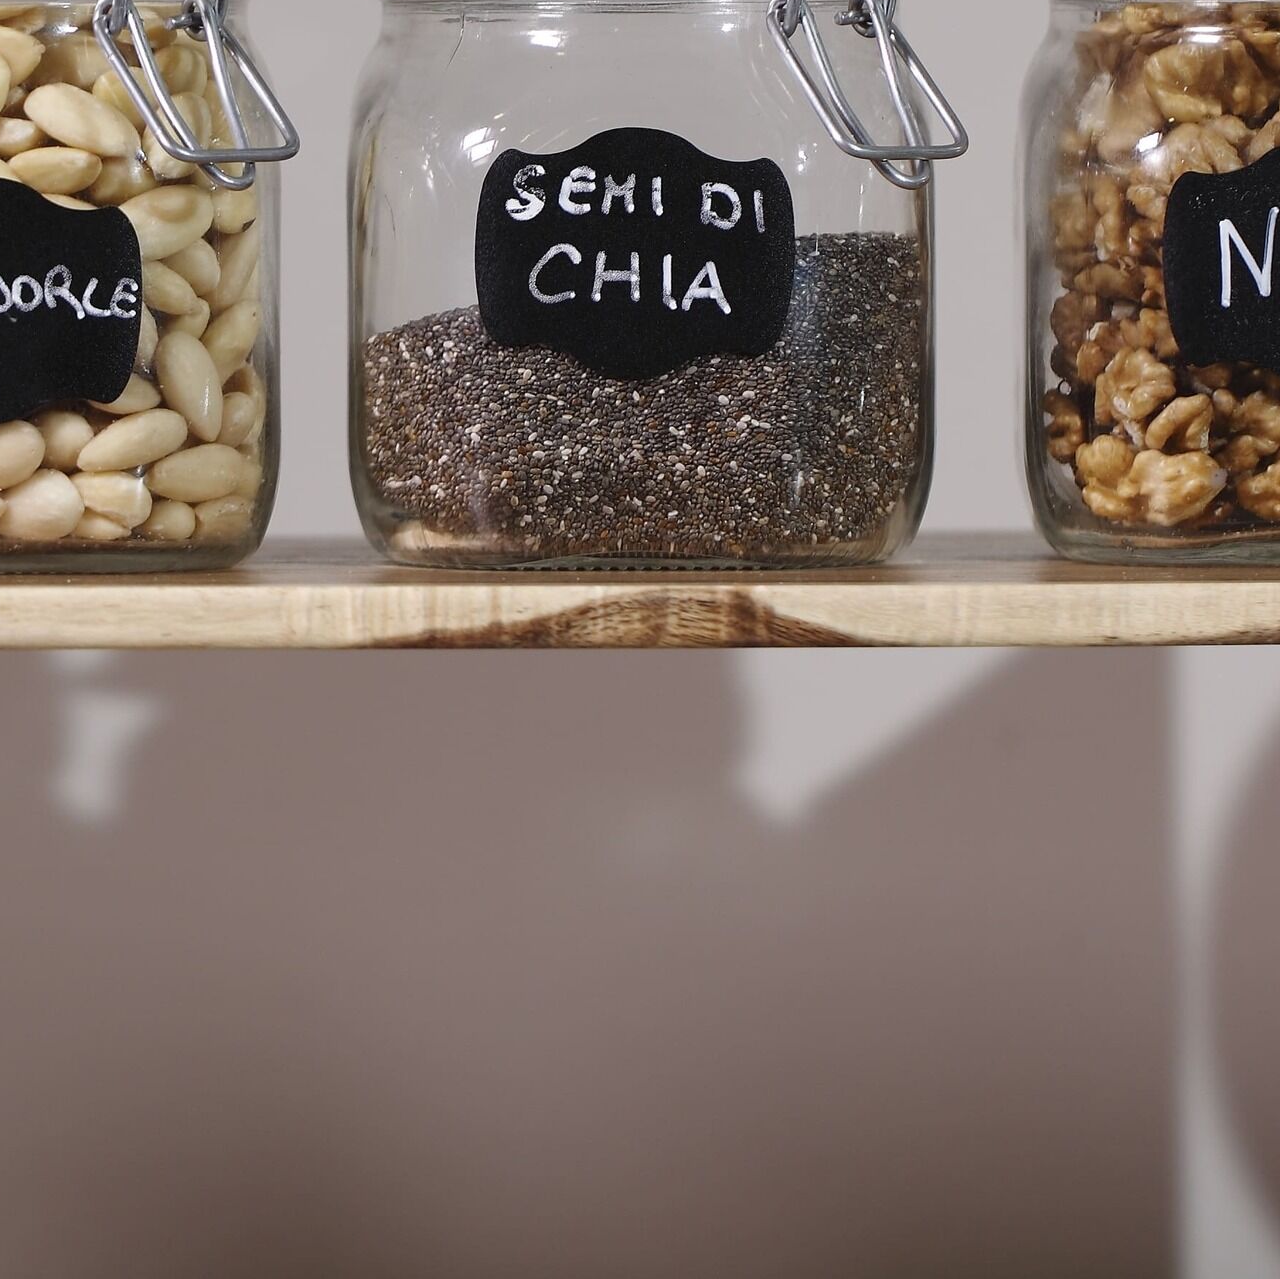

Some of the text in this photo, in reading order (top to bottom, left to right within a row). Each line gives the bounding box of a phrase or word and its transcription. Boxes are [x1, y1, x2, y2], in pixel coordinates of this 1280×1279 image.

[504, 163, 766, 234] SEMI DI
[527, 242, 733, 316] CHIA
